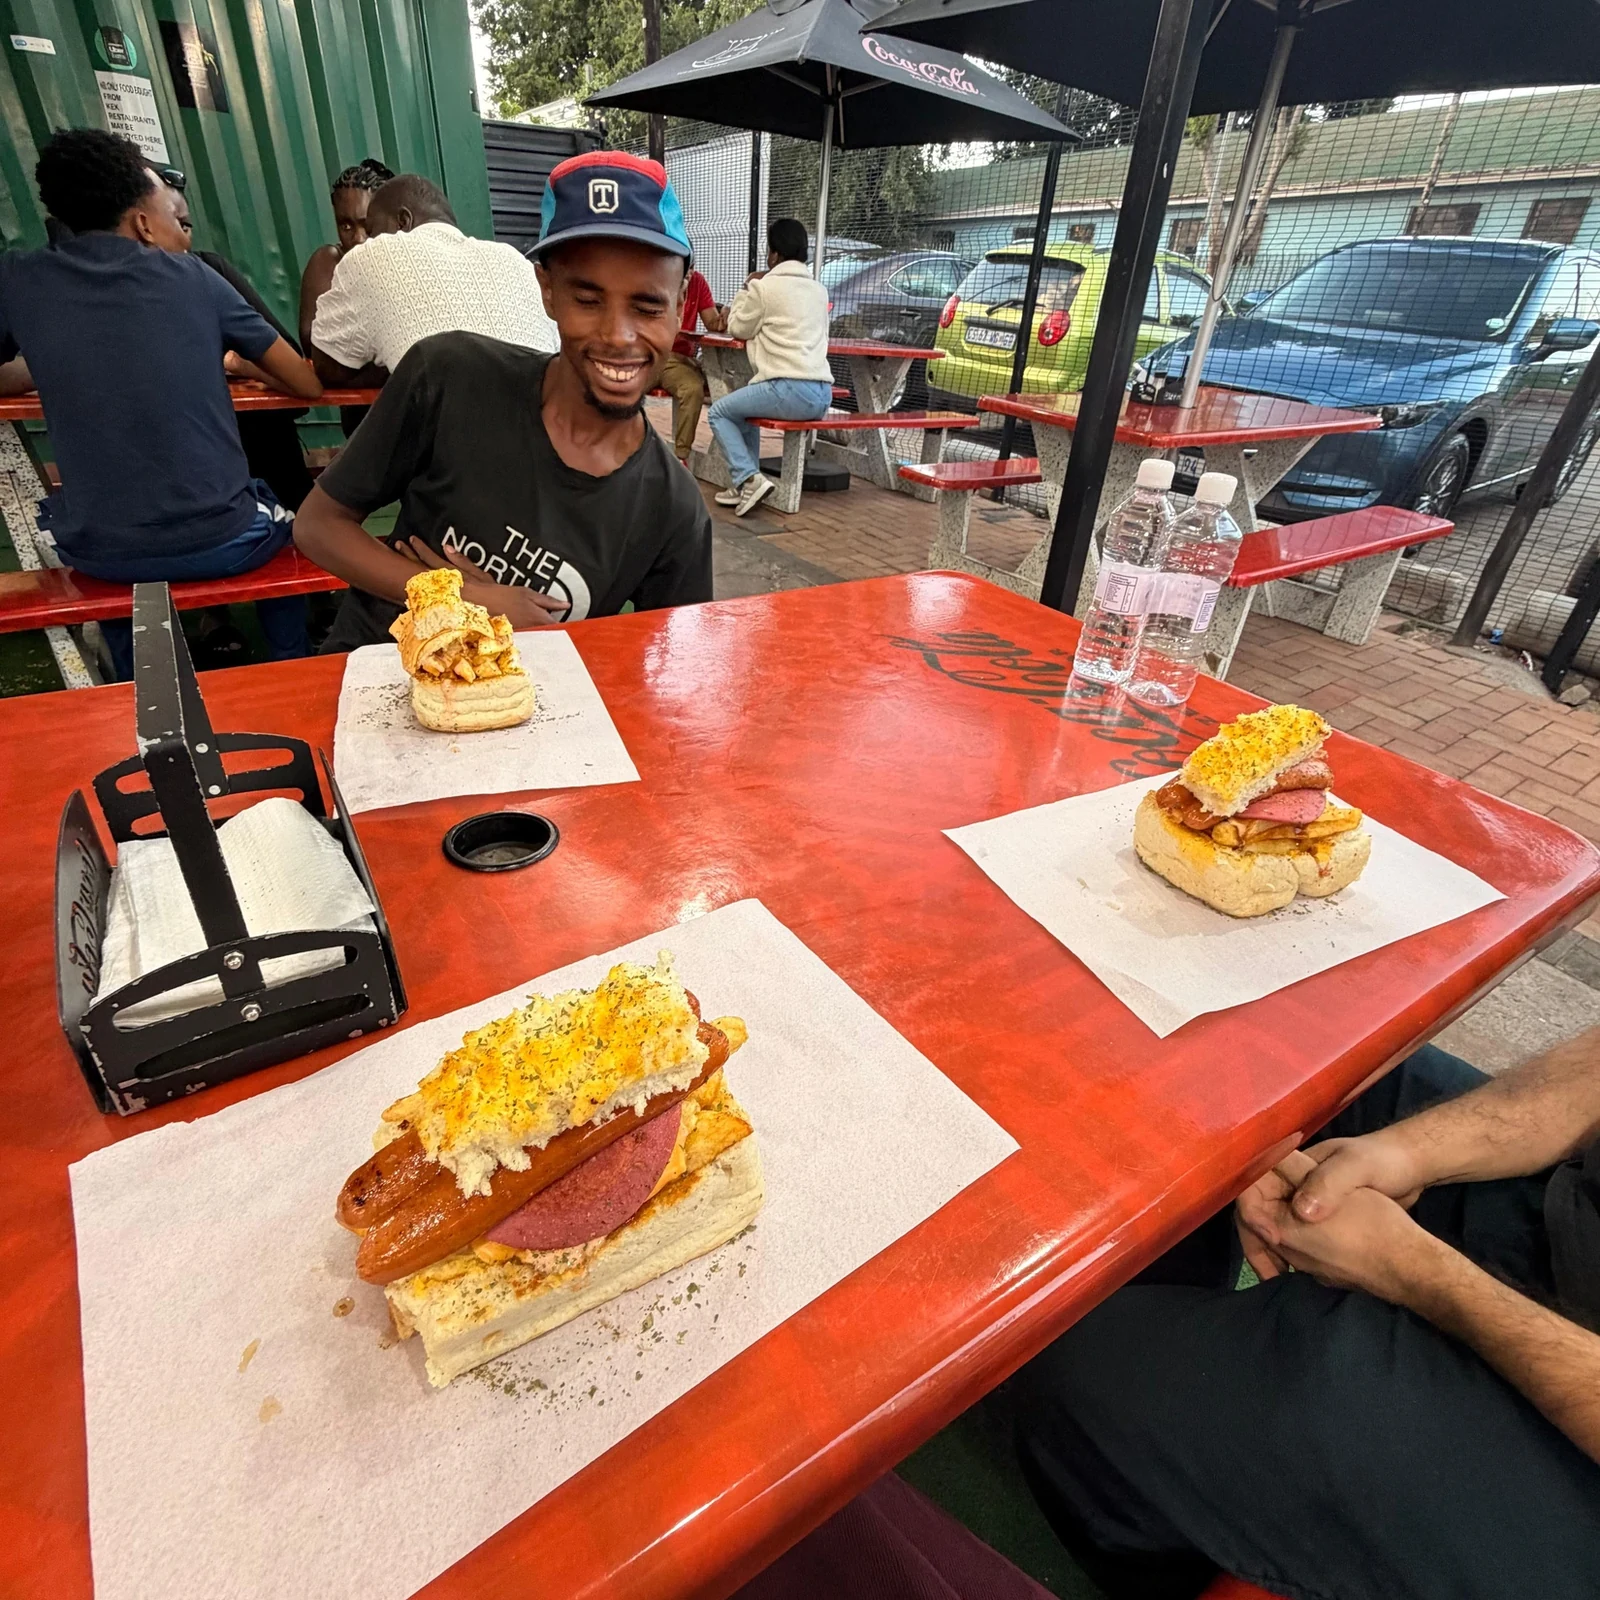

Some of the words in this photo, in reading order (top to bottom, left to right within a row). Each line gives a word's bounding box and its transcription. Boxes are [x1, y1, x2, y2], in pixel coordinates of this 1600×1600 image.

[861, 36, 979, 95] Coca-Cola
[103, 93, 121, 101] FROM
[119, 83, 134, 93] FOOD
[108, 112, 156, 126] RESTAURANTS
[594, 184, 613, 207] T
[502, 525, 560, 580] THE
